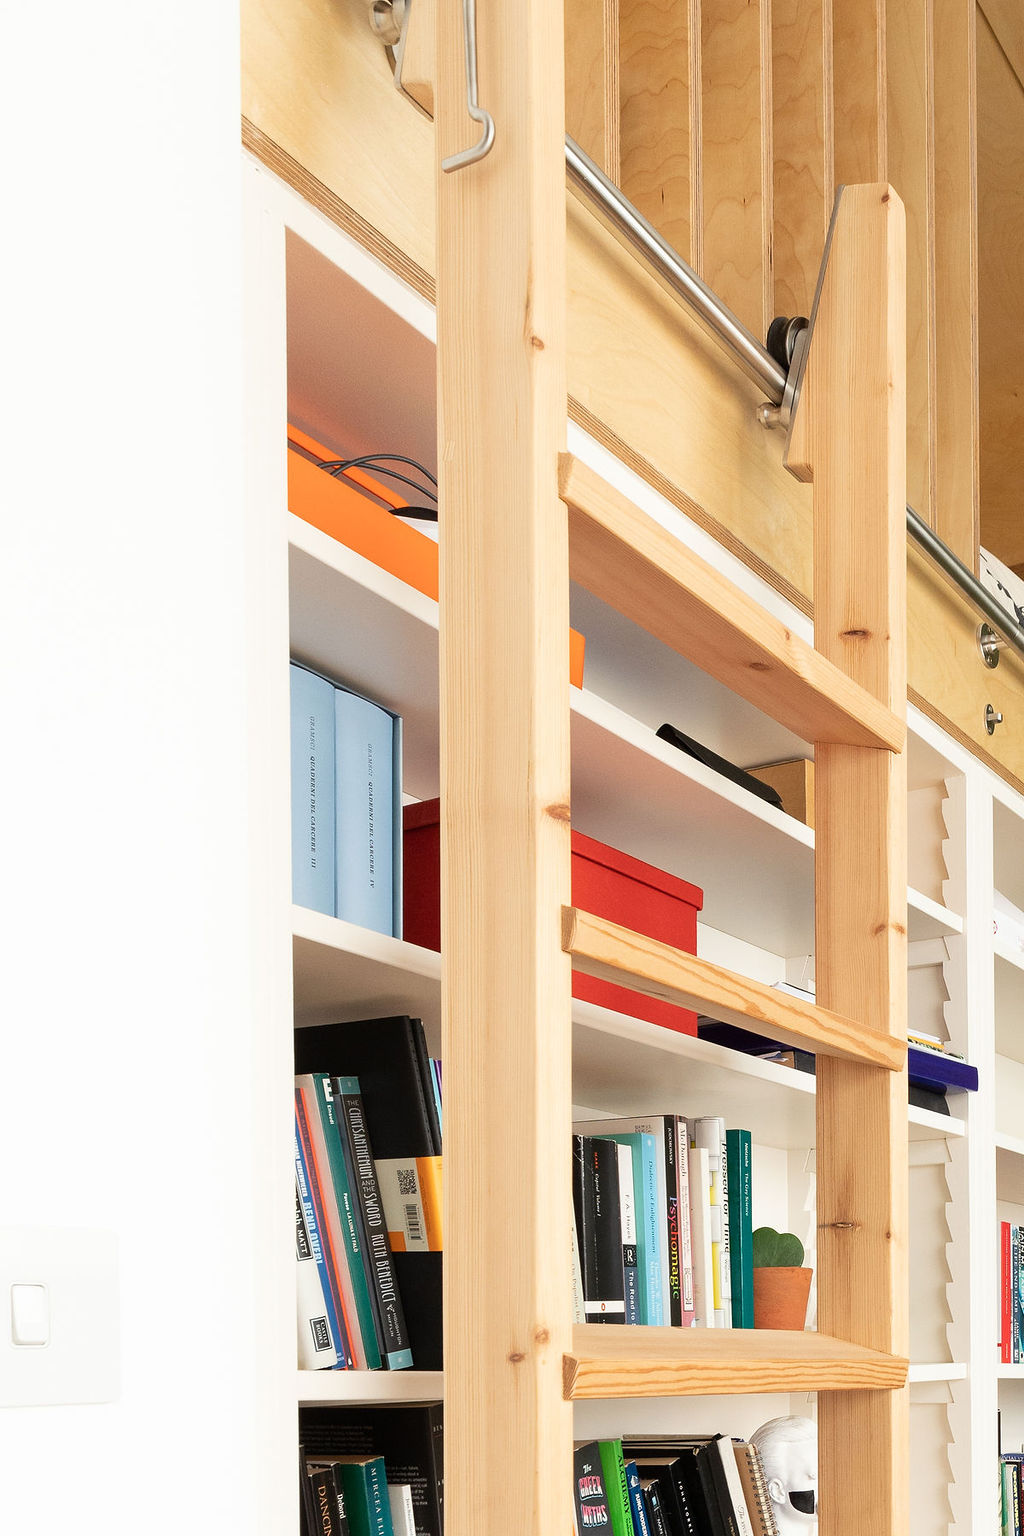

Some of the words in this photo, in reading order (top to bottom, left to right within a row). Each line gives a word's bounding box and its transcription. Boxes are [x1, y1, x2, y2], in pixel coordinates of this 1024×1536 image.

[370, 879, 374, 888] IV
[327, 1104, 335, 1124] Einaudi
[348, 1107, 374, 1180] CHRYSANTHEMUM
[679, 1128, 687, 1177] McDonagh
[303, 1201, 318, 1229] BEND
[363, 1192, 381, 1227] SWORD
[297, 1229, 308, 1254] MATT
[371, 1233, 388, 1259] RUTH
[667, 1196, 681, 1300] Psychomagic
[376, 1260, 397, 1303] BENEDICT
[393, 1312, 402, 1345] HOUGHTON
[630, 1310, 636, 1321] to
[320, 1322, 328, 1343] CASTLE
[583, 1464, 592, 1474] The
[370, 1467, 382, 1514] MIRCEA
[579, 1475, 604, 1498] GREEK
[617, 1455, 630, 1514] ALCHEMY
[337, 1493, 346, 1519] Debord
[581, 1504, 608, 1525] MYTHS
[634, 1492, 642, 1511] JUNG
